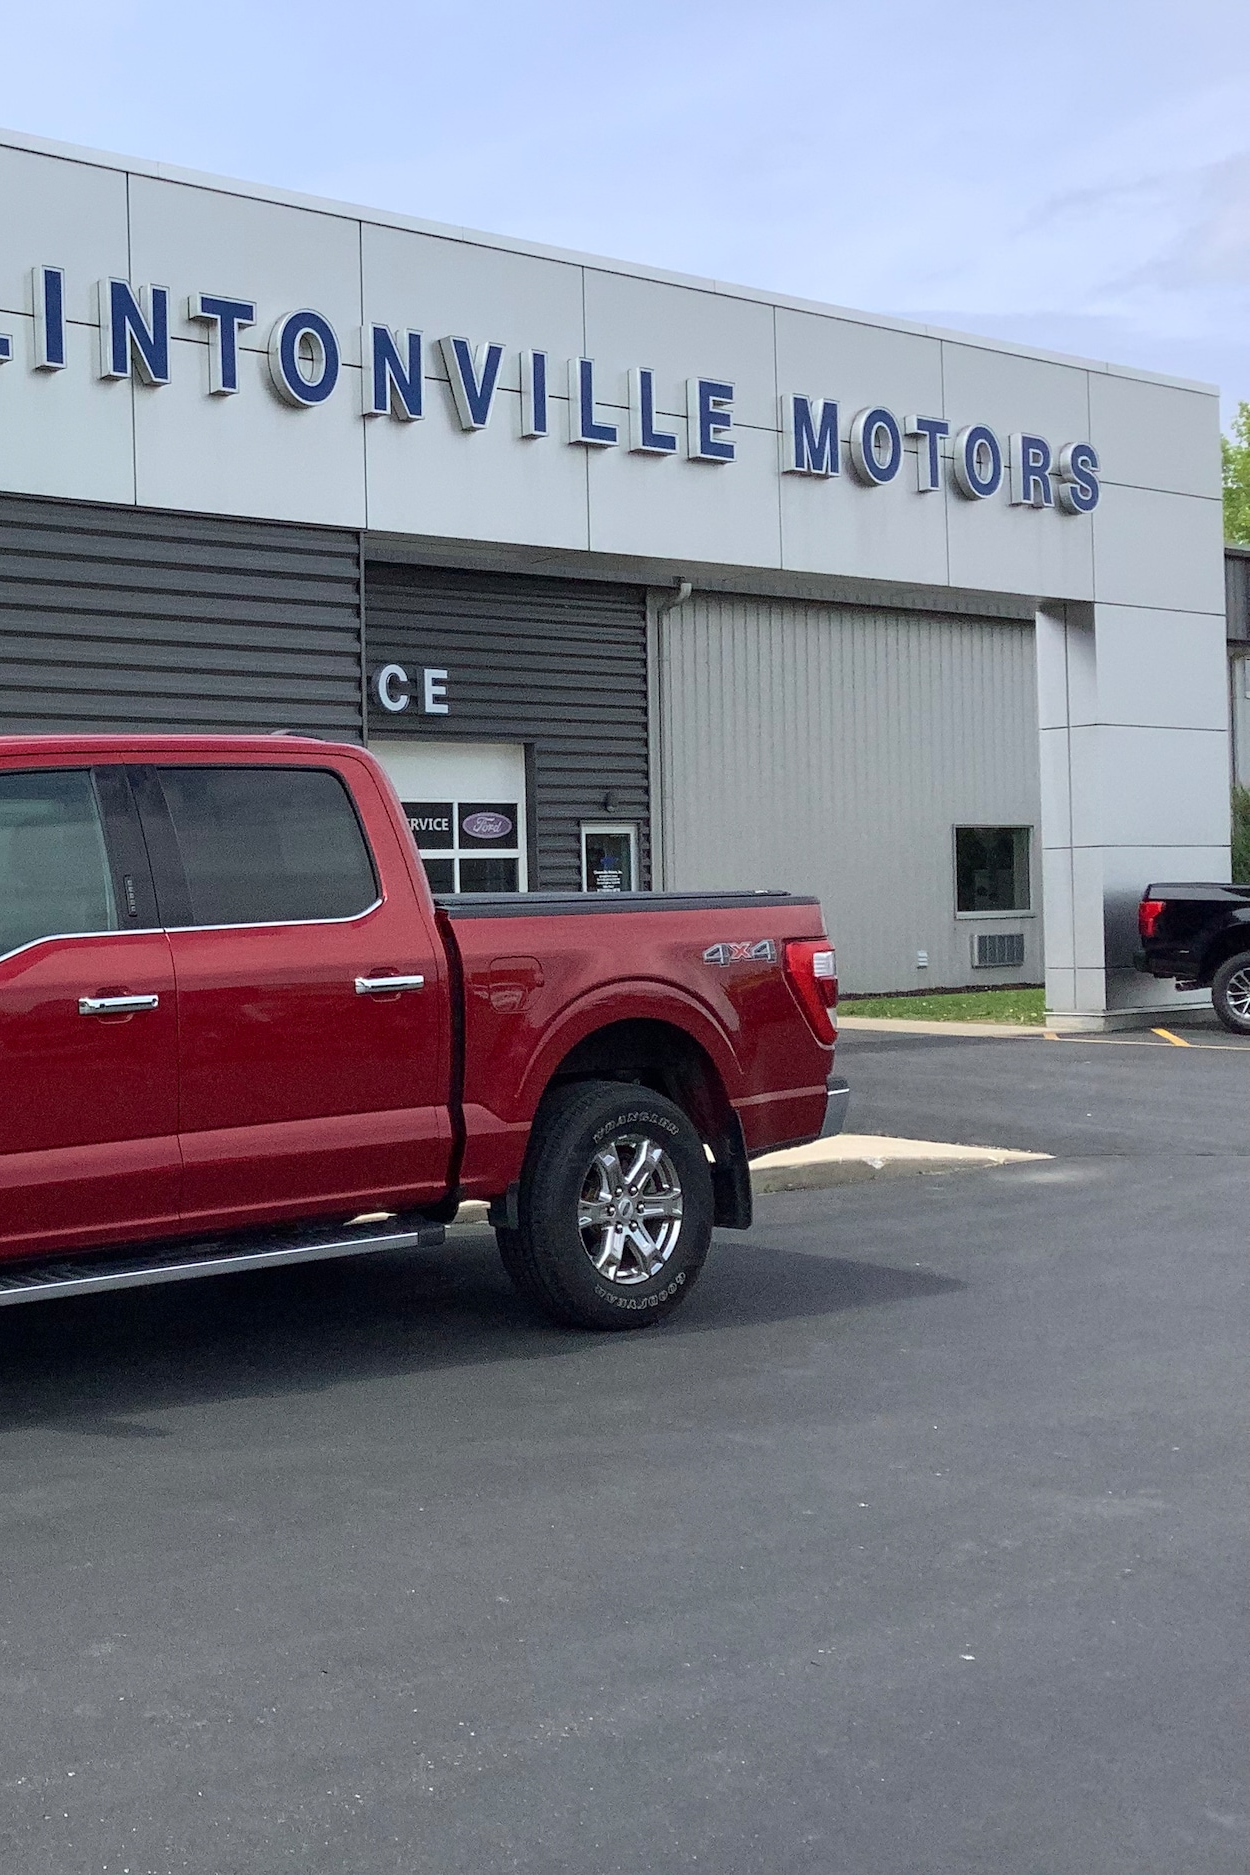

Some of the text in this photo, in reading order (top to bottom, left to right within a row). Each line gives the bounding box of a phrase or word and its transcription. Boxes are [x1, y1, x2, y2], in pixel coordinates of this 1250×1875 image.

[781, 392, 1101, 515] MOTORS
[408, 818, 450, 831] RVICE
[472, 816, 502, 833] Ford
[592, 1111, 680, 1143] WRANGLER
